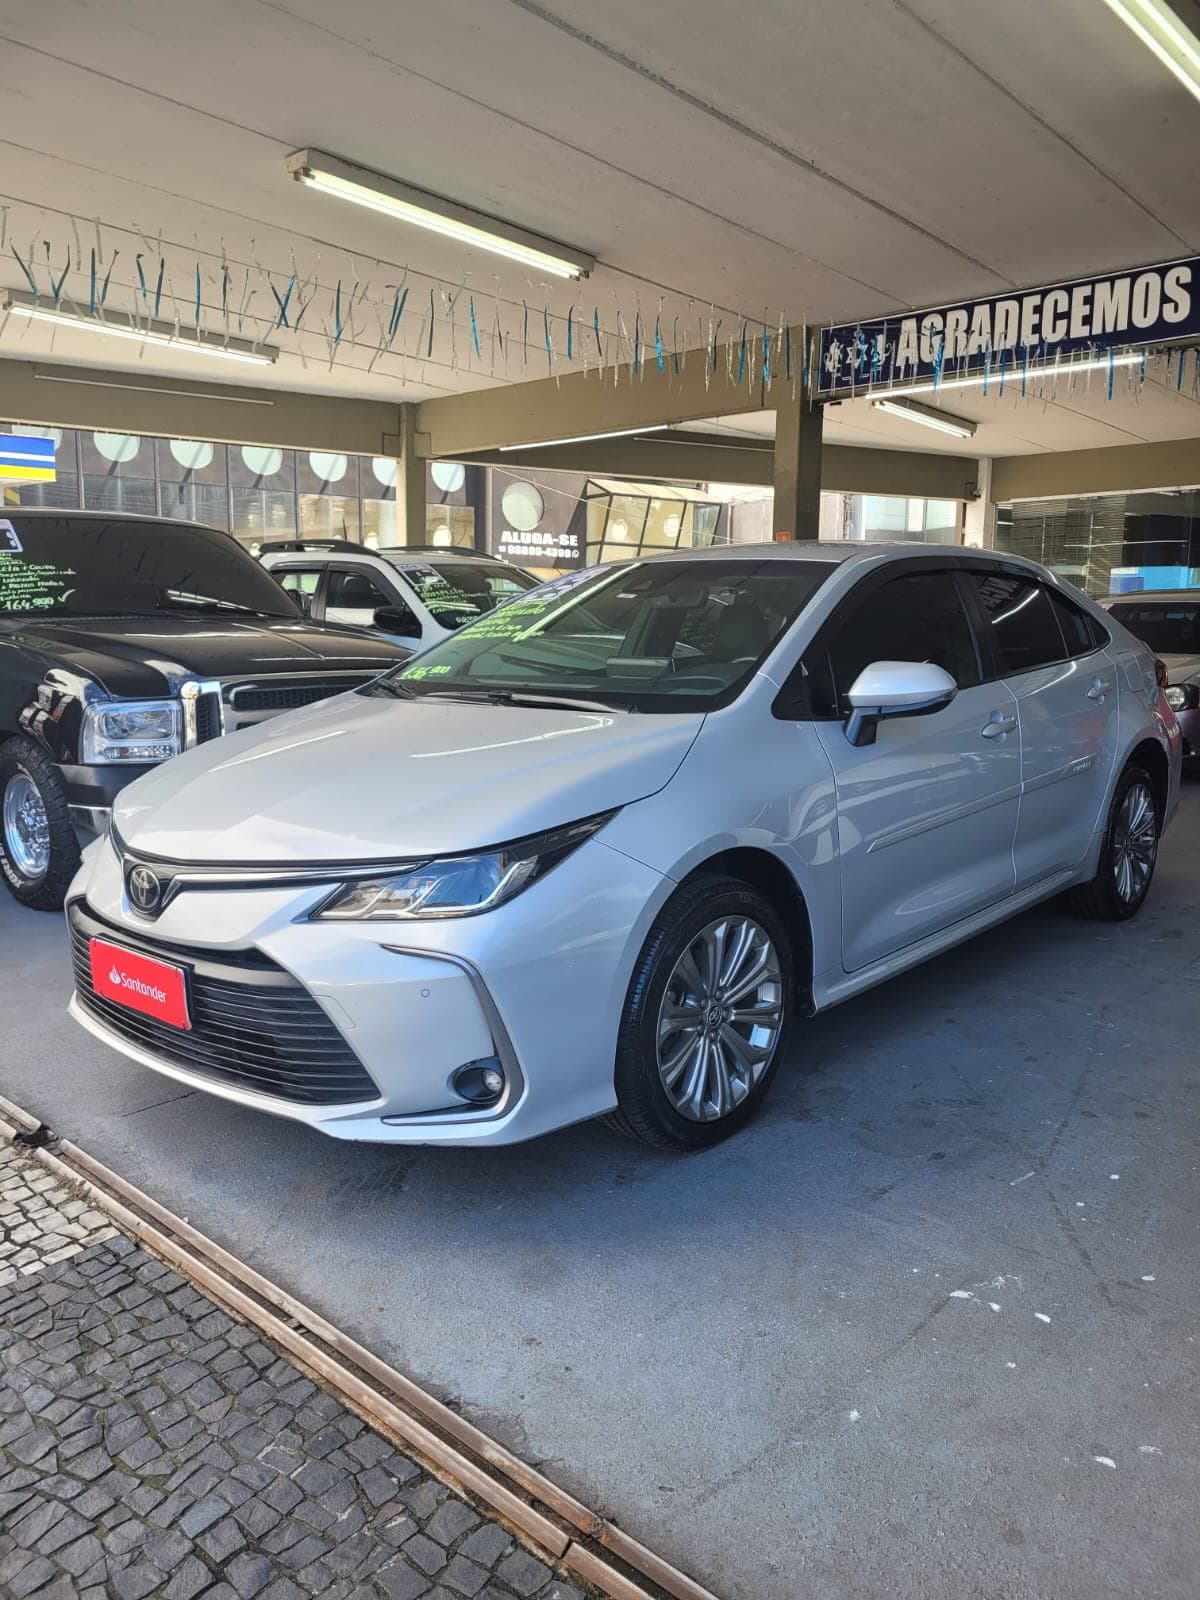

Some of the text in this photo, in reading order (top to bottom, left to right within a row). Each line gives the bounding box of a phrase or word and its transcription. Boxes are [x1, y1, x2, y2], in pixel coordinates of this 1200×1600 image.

[896, 265, 1193, 368] AGRADECEMOS
[501, 531, 578, 546] ALUGA-SE
[121, 972, 167, 1004] Santander
